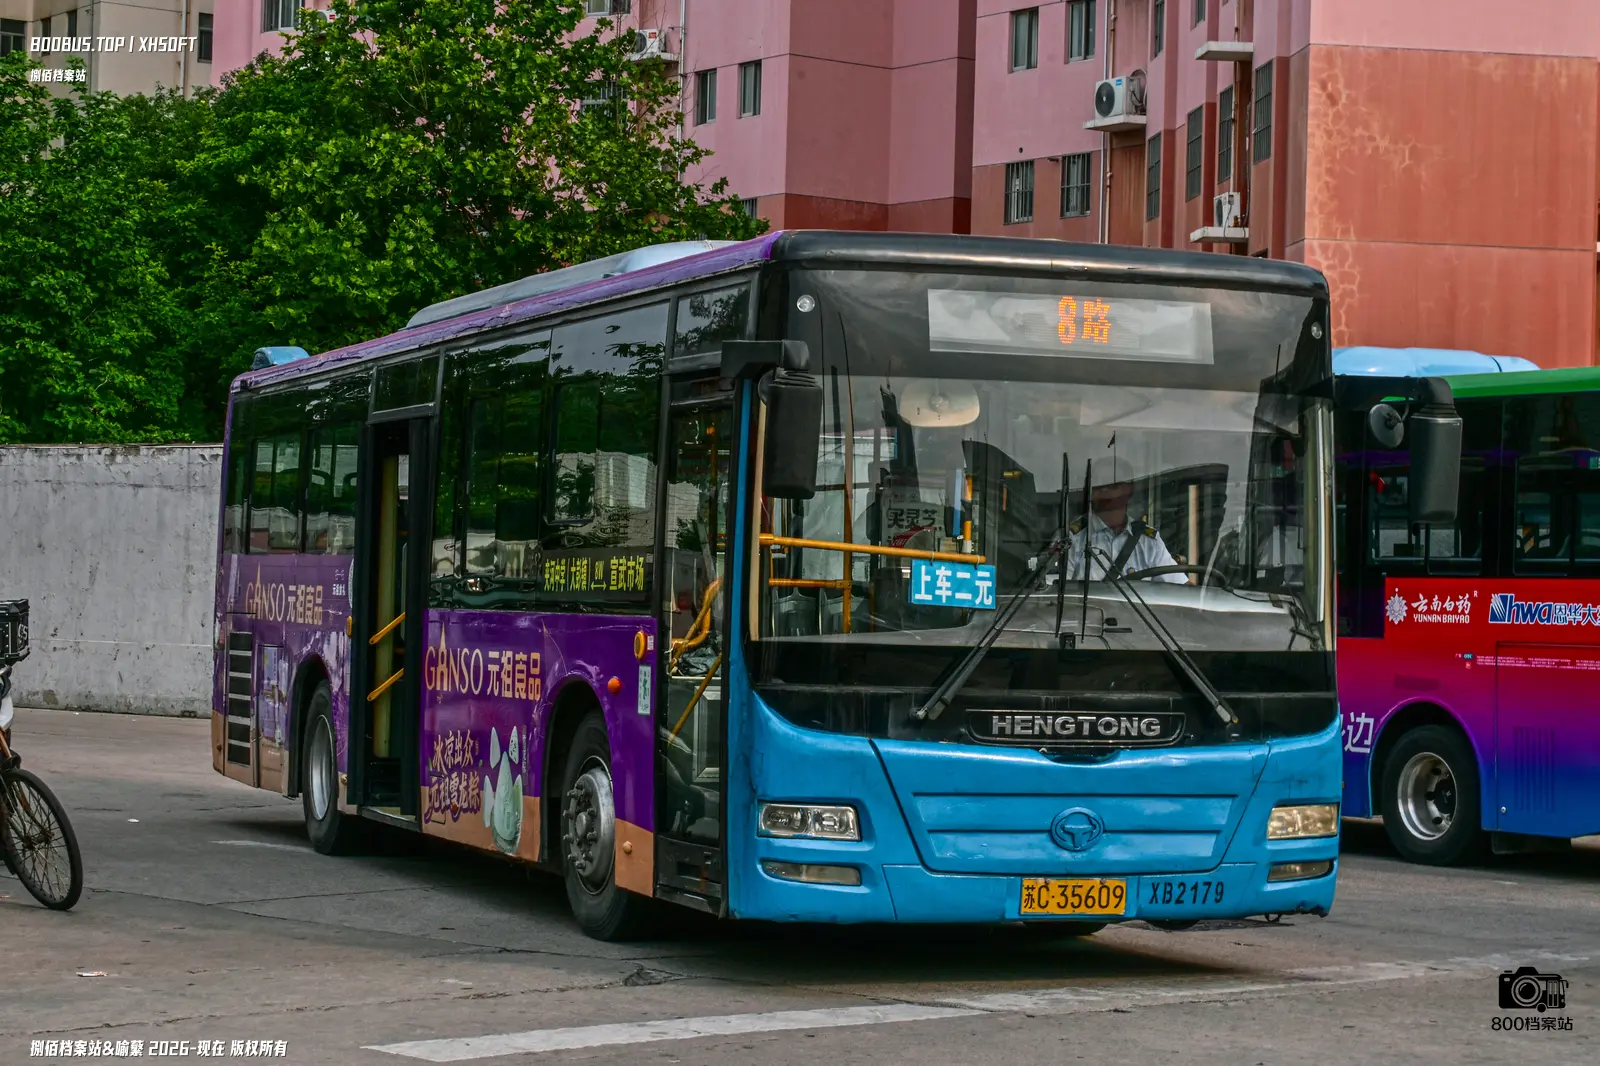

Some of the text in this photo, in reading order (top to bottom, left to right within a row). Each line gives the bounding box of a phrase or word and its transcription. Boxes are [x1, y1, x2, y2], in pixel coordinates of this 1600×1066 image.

[1058, 296, 1112, 344] 8路
[609, 555, 644, 591] 宣武市场
[914, 565, 993, 605] 上车二元
[246, 562, 285, 621] GANSO
[1411, 593, 1471, 614] 云南白药
[1413, 613, 1470, 624] YUNNAN BAIYAO
[1553, 602, 1600, 626] 恩华大
[425, 622, 483, 695] GANSO
[992, 715, 1161, 737] HENGTONG
[1340, 711, 1375, 754] 边
[1149, 881, 1225, 904] XB2179
